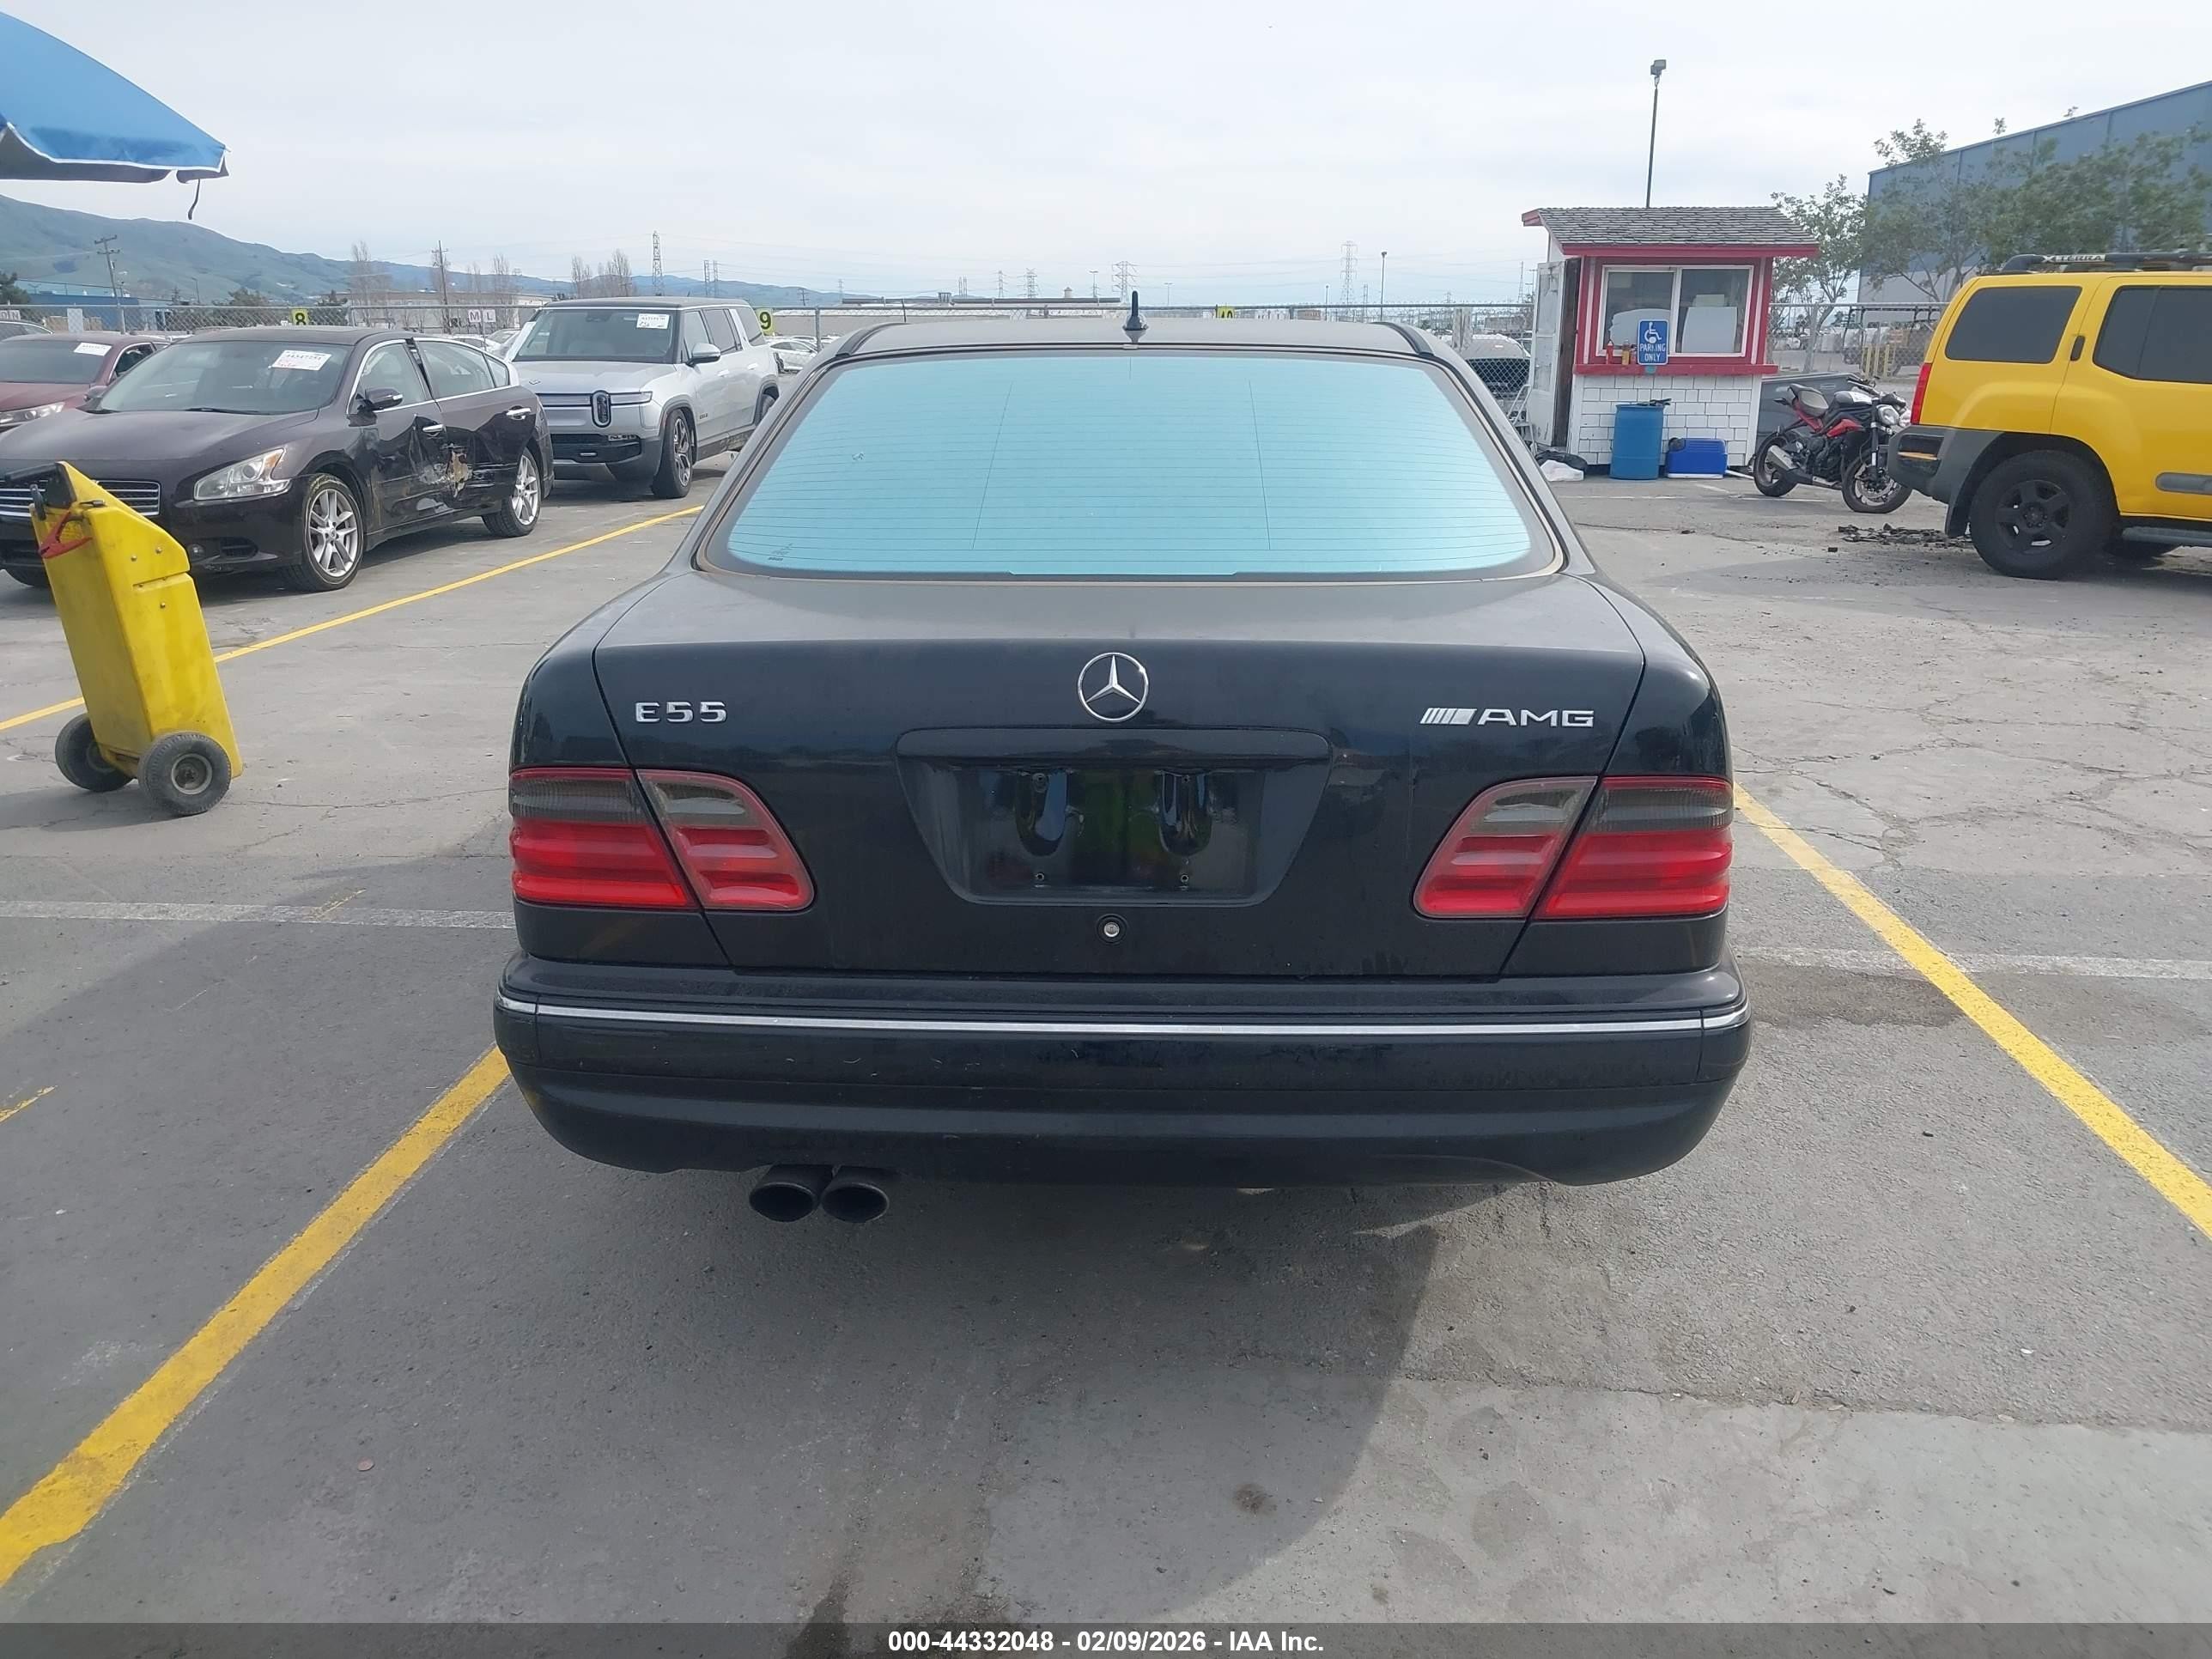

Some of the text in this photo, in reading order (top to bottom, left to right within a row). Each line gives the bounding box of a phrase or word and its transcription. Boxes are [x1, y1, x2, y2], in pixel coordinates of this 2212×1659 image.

[295, 313, 307, 325] 8
[469, 311, 480, 321] M
[759, 311, 771, 330] 9
[1640, 343, 1666, 352] PARKING
[1644, 353, 1661, 362] ONLY
[635, 702, 727, 722] E55
[1477, 708, 1595, 727] AMG
